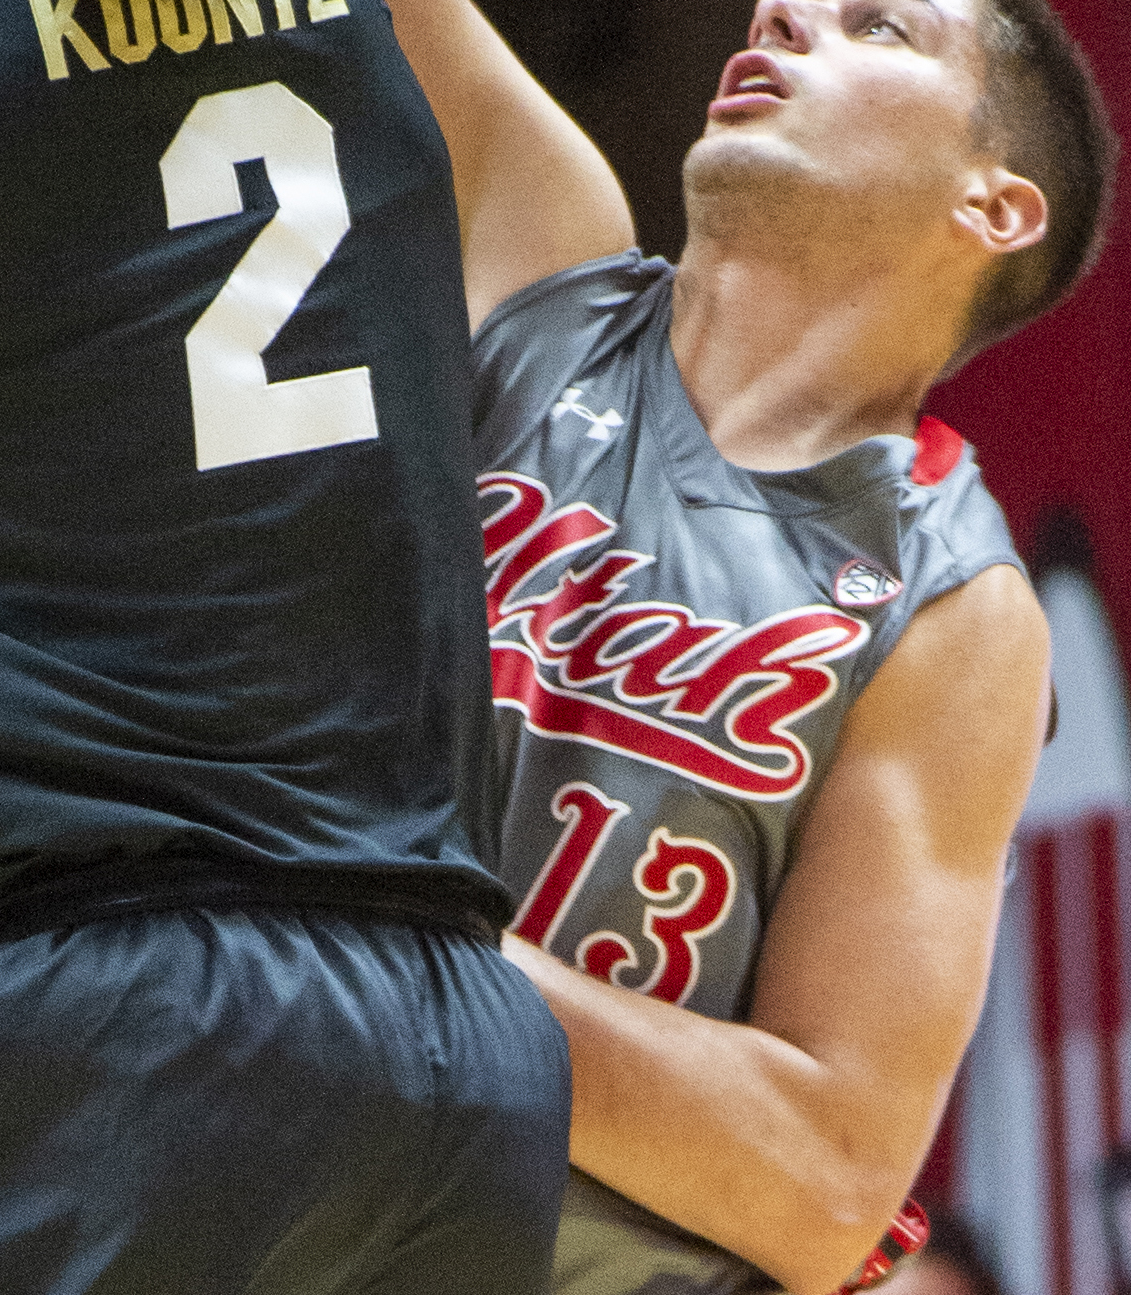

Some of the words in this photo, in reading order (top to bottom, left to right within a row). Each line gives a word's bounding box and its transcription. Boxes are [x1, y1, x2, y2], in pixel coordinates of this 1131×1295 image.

[159, 81, 379, 472] 2
[476, 471, 870, 801] Utah
[506, 781, 736, 1006] 13
